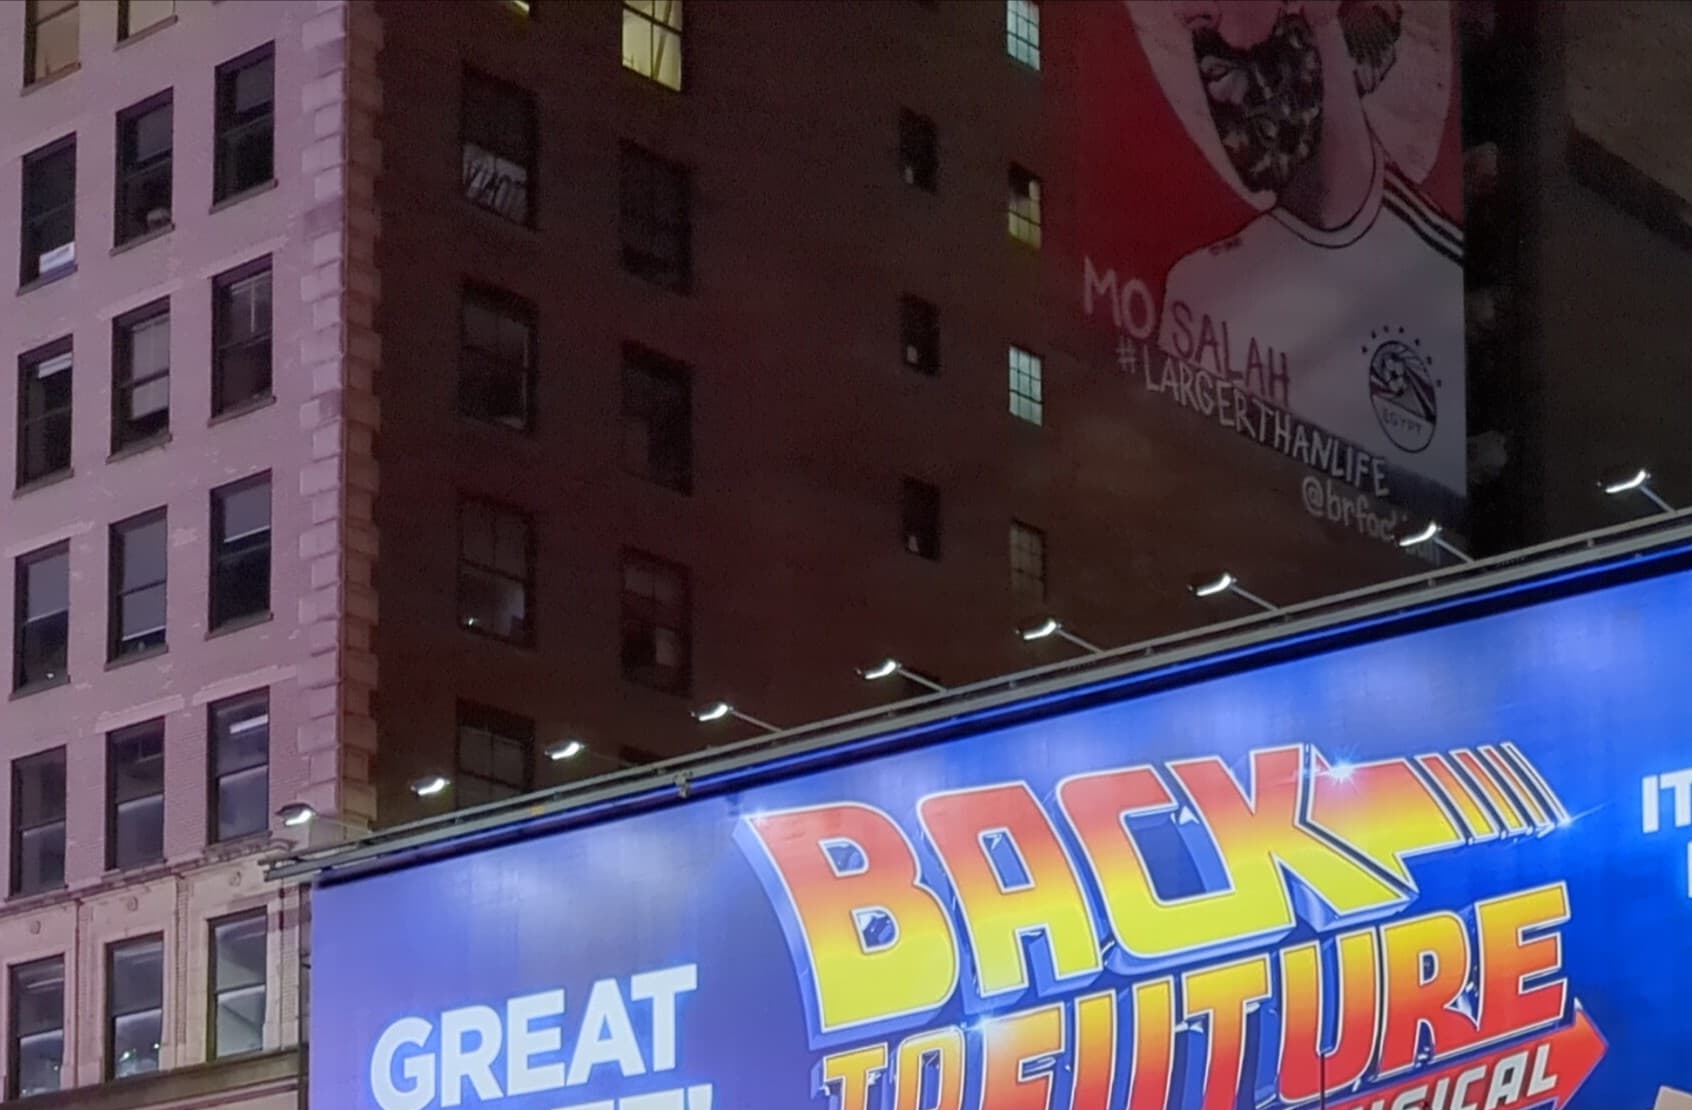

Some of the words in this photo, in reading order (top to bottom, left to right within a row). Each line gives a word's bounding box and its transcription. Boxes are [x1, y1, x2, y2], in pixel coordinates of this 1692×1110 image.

[1084, 256, 1156, 340] MO
[1171, 300, 1290, 408] SALAH
[740, 742, 1420, 1045] BACK
